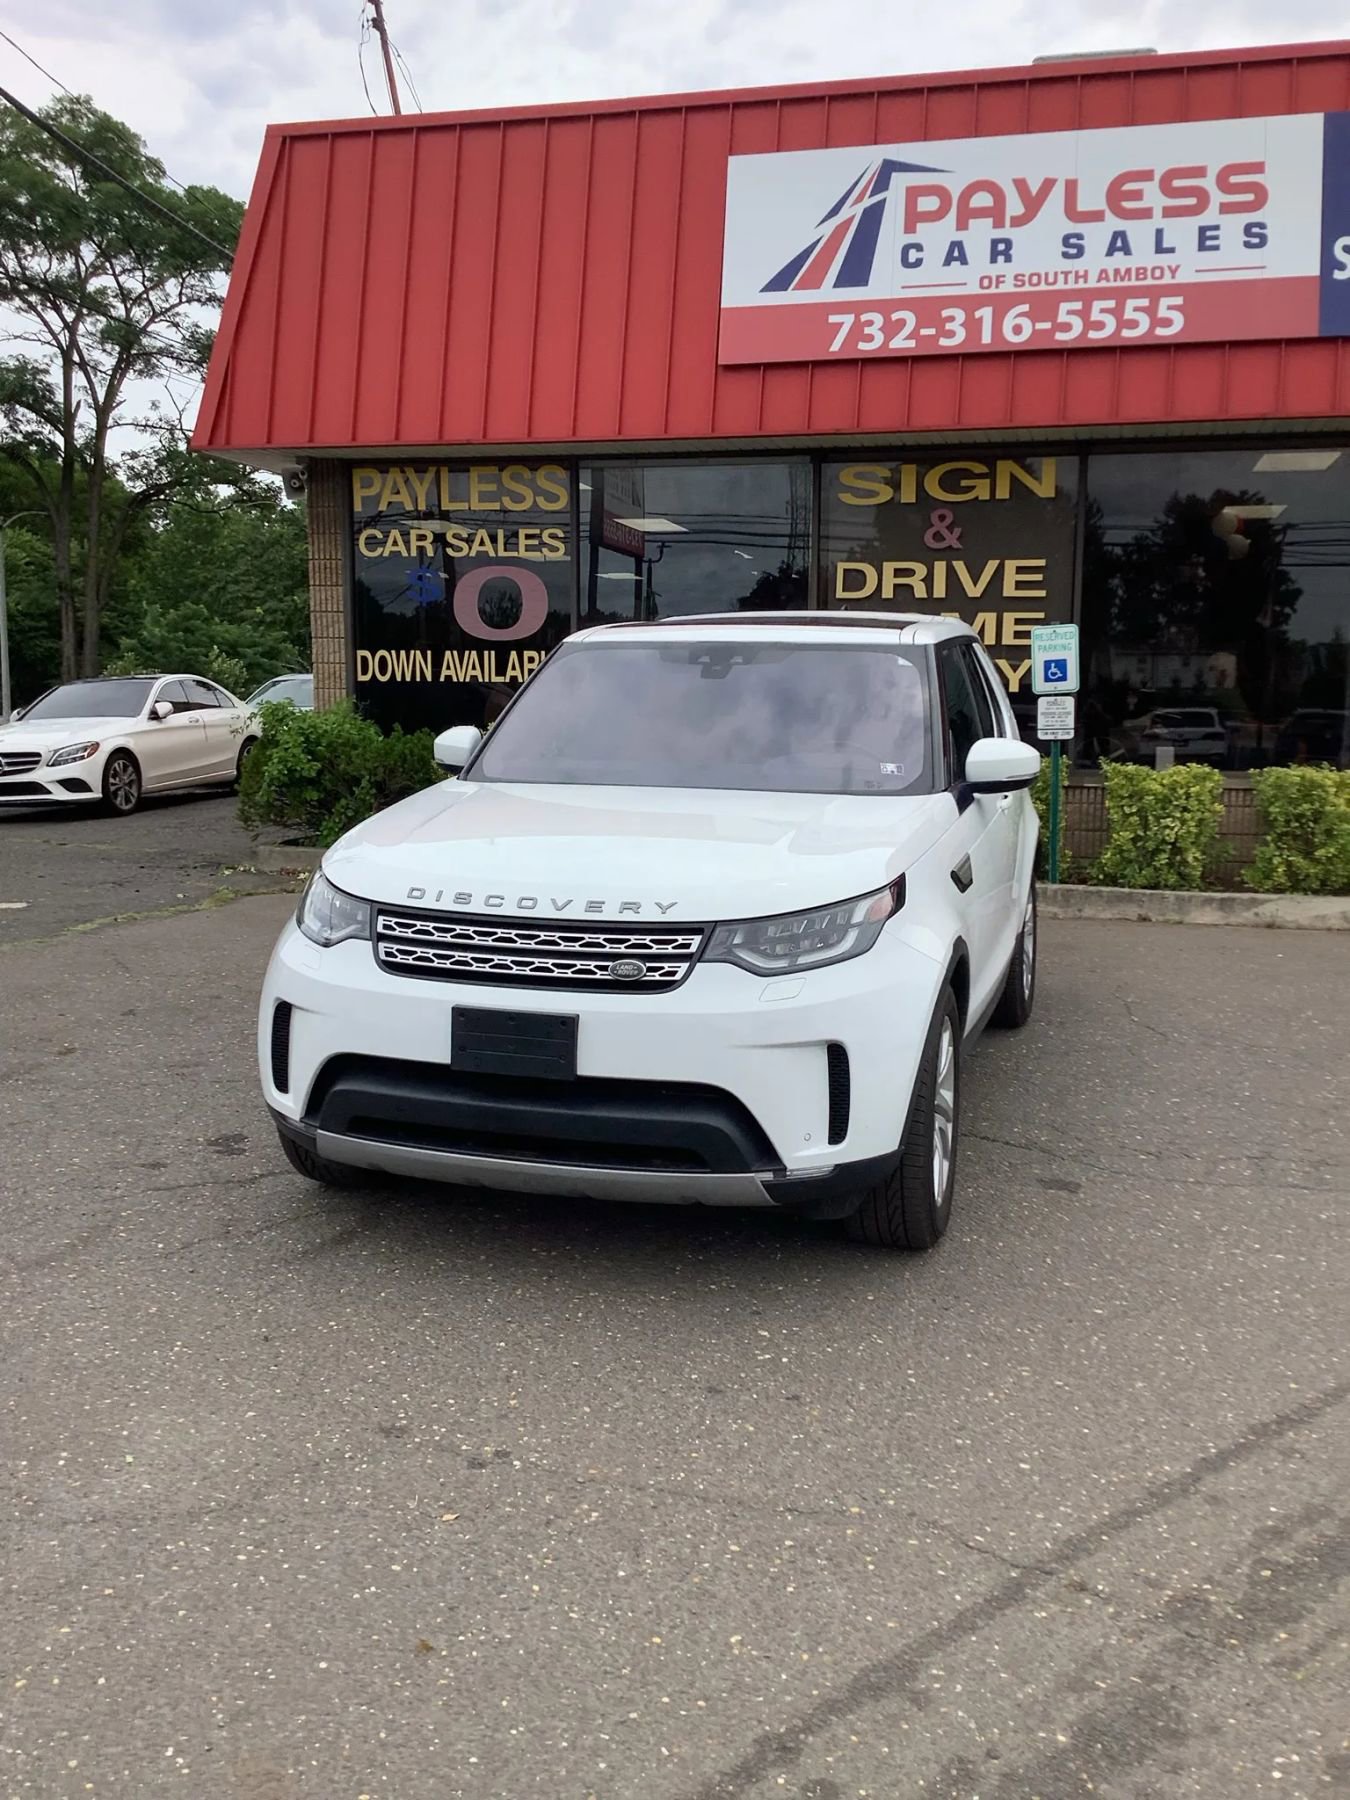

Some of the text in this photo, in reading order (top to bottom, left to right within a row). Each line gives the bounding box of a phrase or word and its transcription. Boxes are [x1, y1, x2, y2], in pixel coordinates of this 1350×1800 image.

[903, 160, 1269, 234] PAYLESS
[901, 221, 1269, 269] CAR SALES
[979, 264, 1181, 290] OF SOUTH AMBOY
[827, 296, 1185, 352] 732-316-5555
[352, 464, 569, 512] PAYLESS
[838, 458, 1057, 505] SIGN
[358, 527, 566, 558] CAR SALES
[923, 508, 963, 550] &
[835, 558, 1047, 599] DRIVE
[1034, 631, 1075, 642] RESERVED
[1037, 642, 1073, 653] PARKING
[356, 649, 546, 682] DOWN AVAILAB
[407, 886, 679, 915] DISCOVERY
